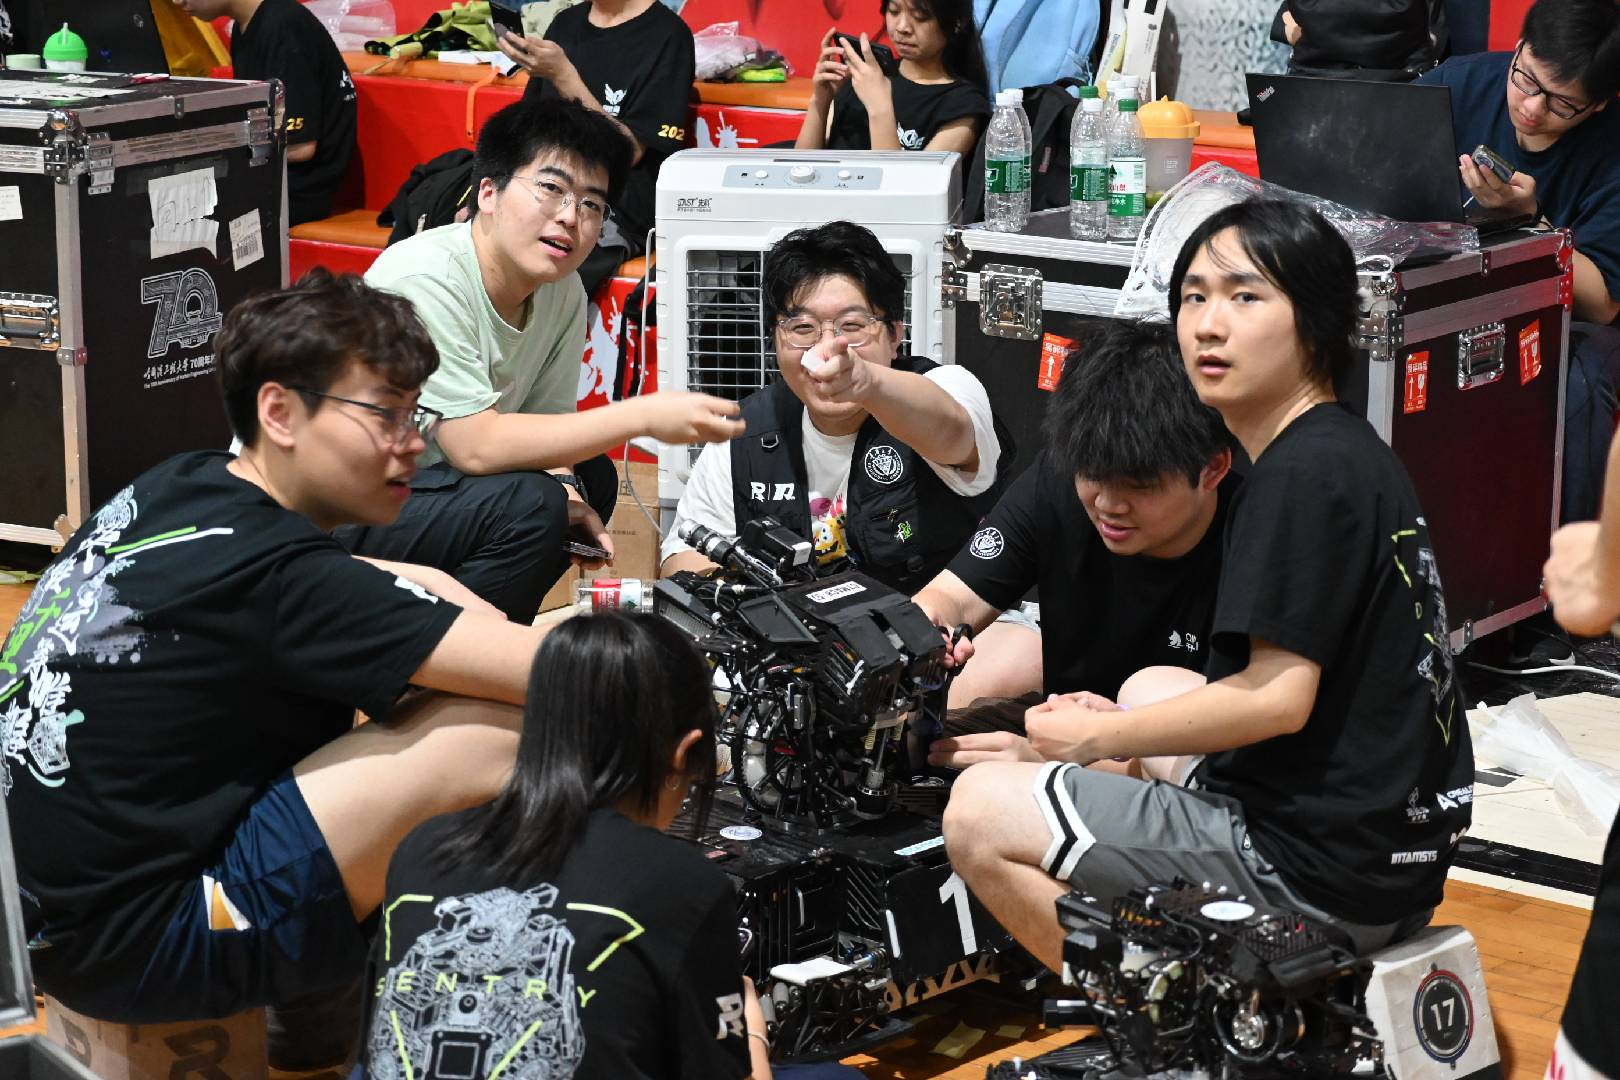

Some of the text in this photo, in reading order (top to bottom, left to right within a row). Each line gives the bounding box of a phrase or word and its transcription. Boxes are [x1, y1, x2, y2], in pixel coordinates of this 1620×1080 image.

[939, 871, 978, 956] 1
[374, 970, 597, 1009] SENTRY
[1430, 997, 1455, 1031] 17
